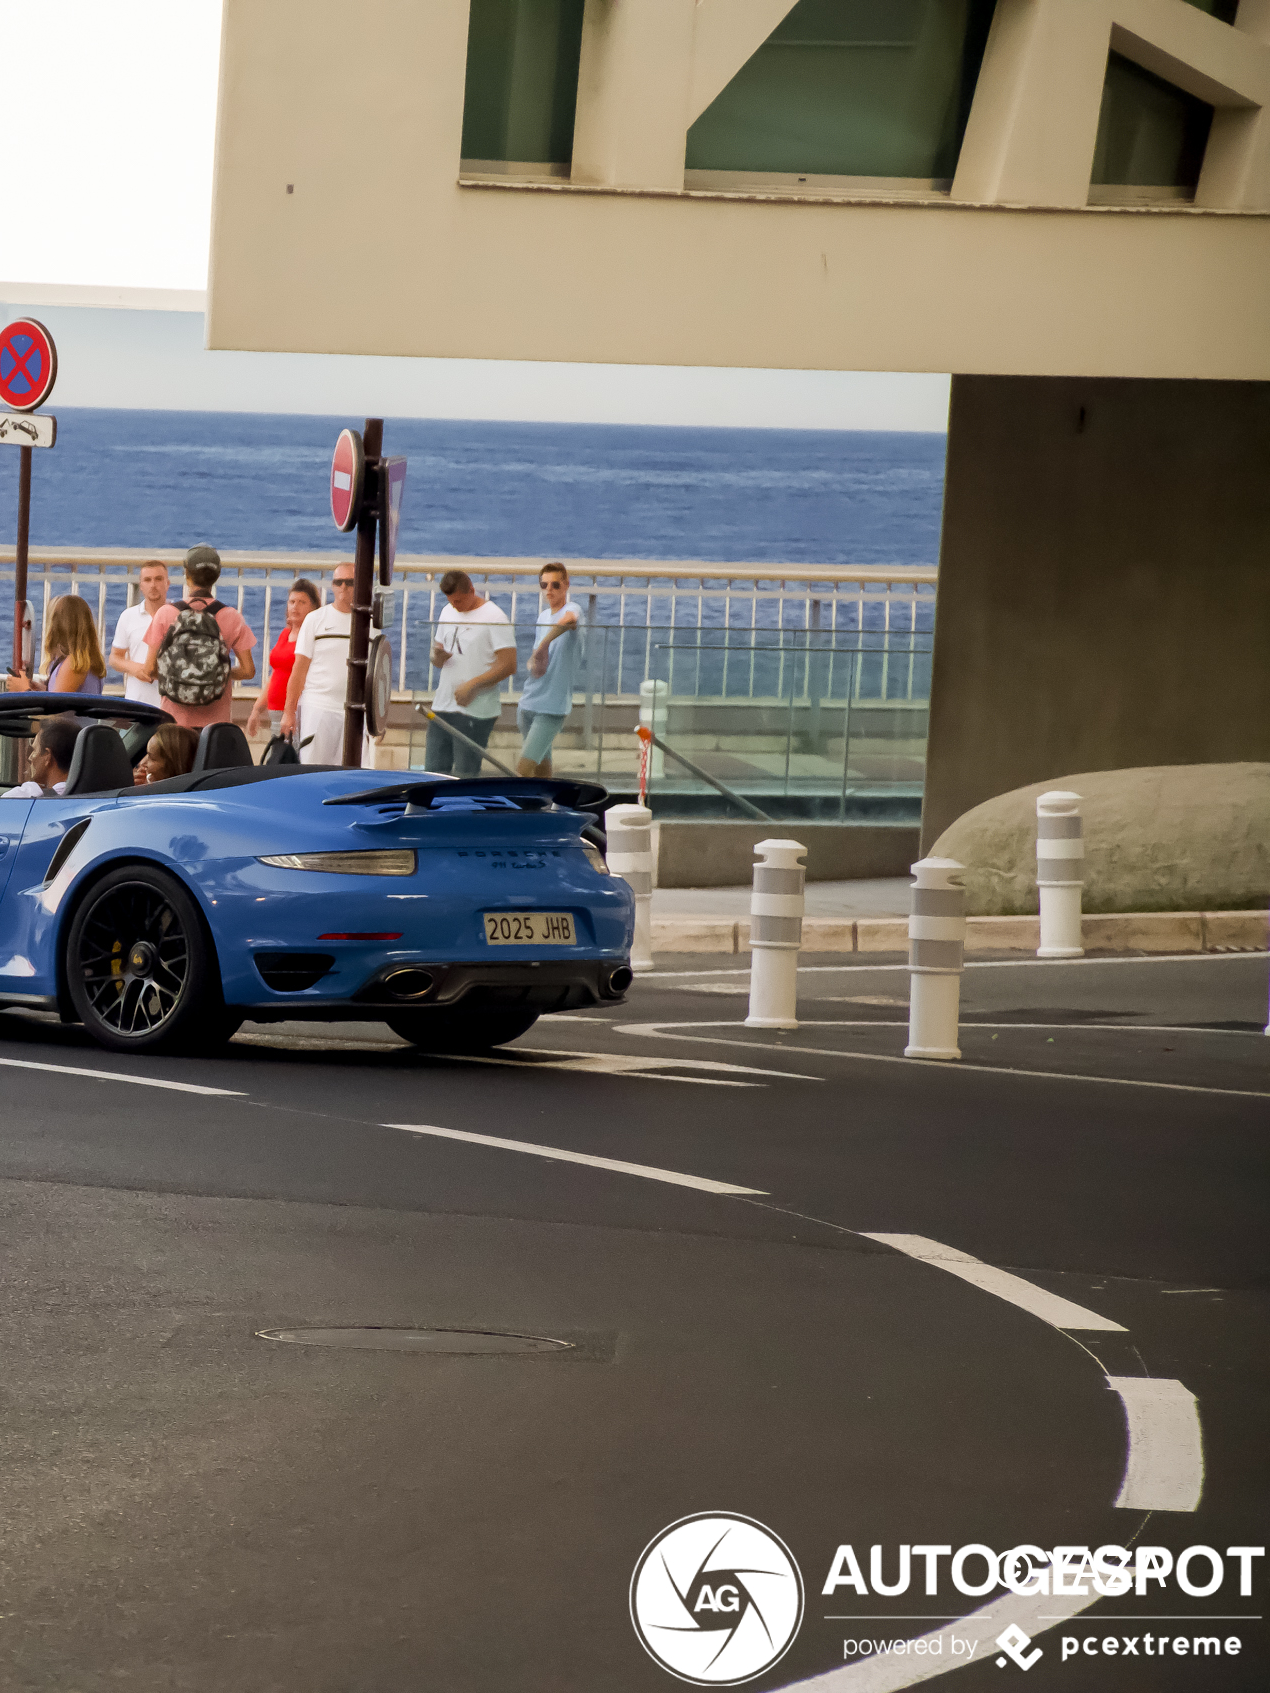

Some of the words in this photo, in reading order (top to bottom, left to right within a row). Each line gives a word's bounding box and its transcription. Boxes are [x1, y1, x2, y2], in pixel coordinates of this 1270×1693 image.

[491, 861, 507, 869] 911
[487, 917, 534, 940] 2025
[542, 917, 571, 940] JHB
